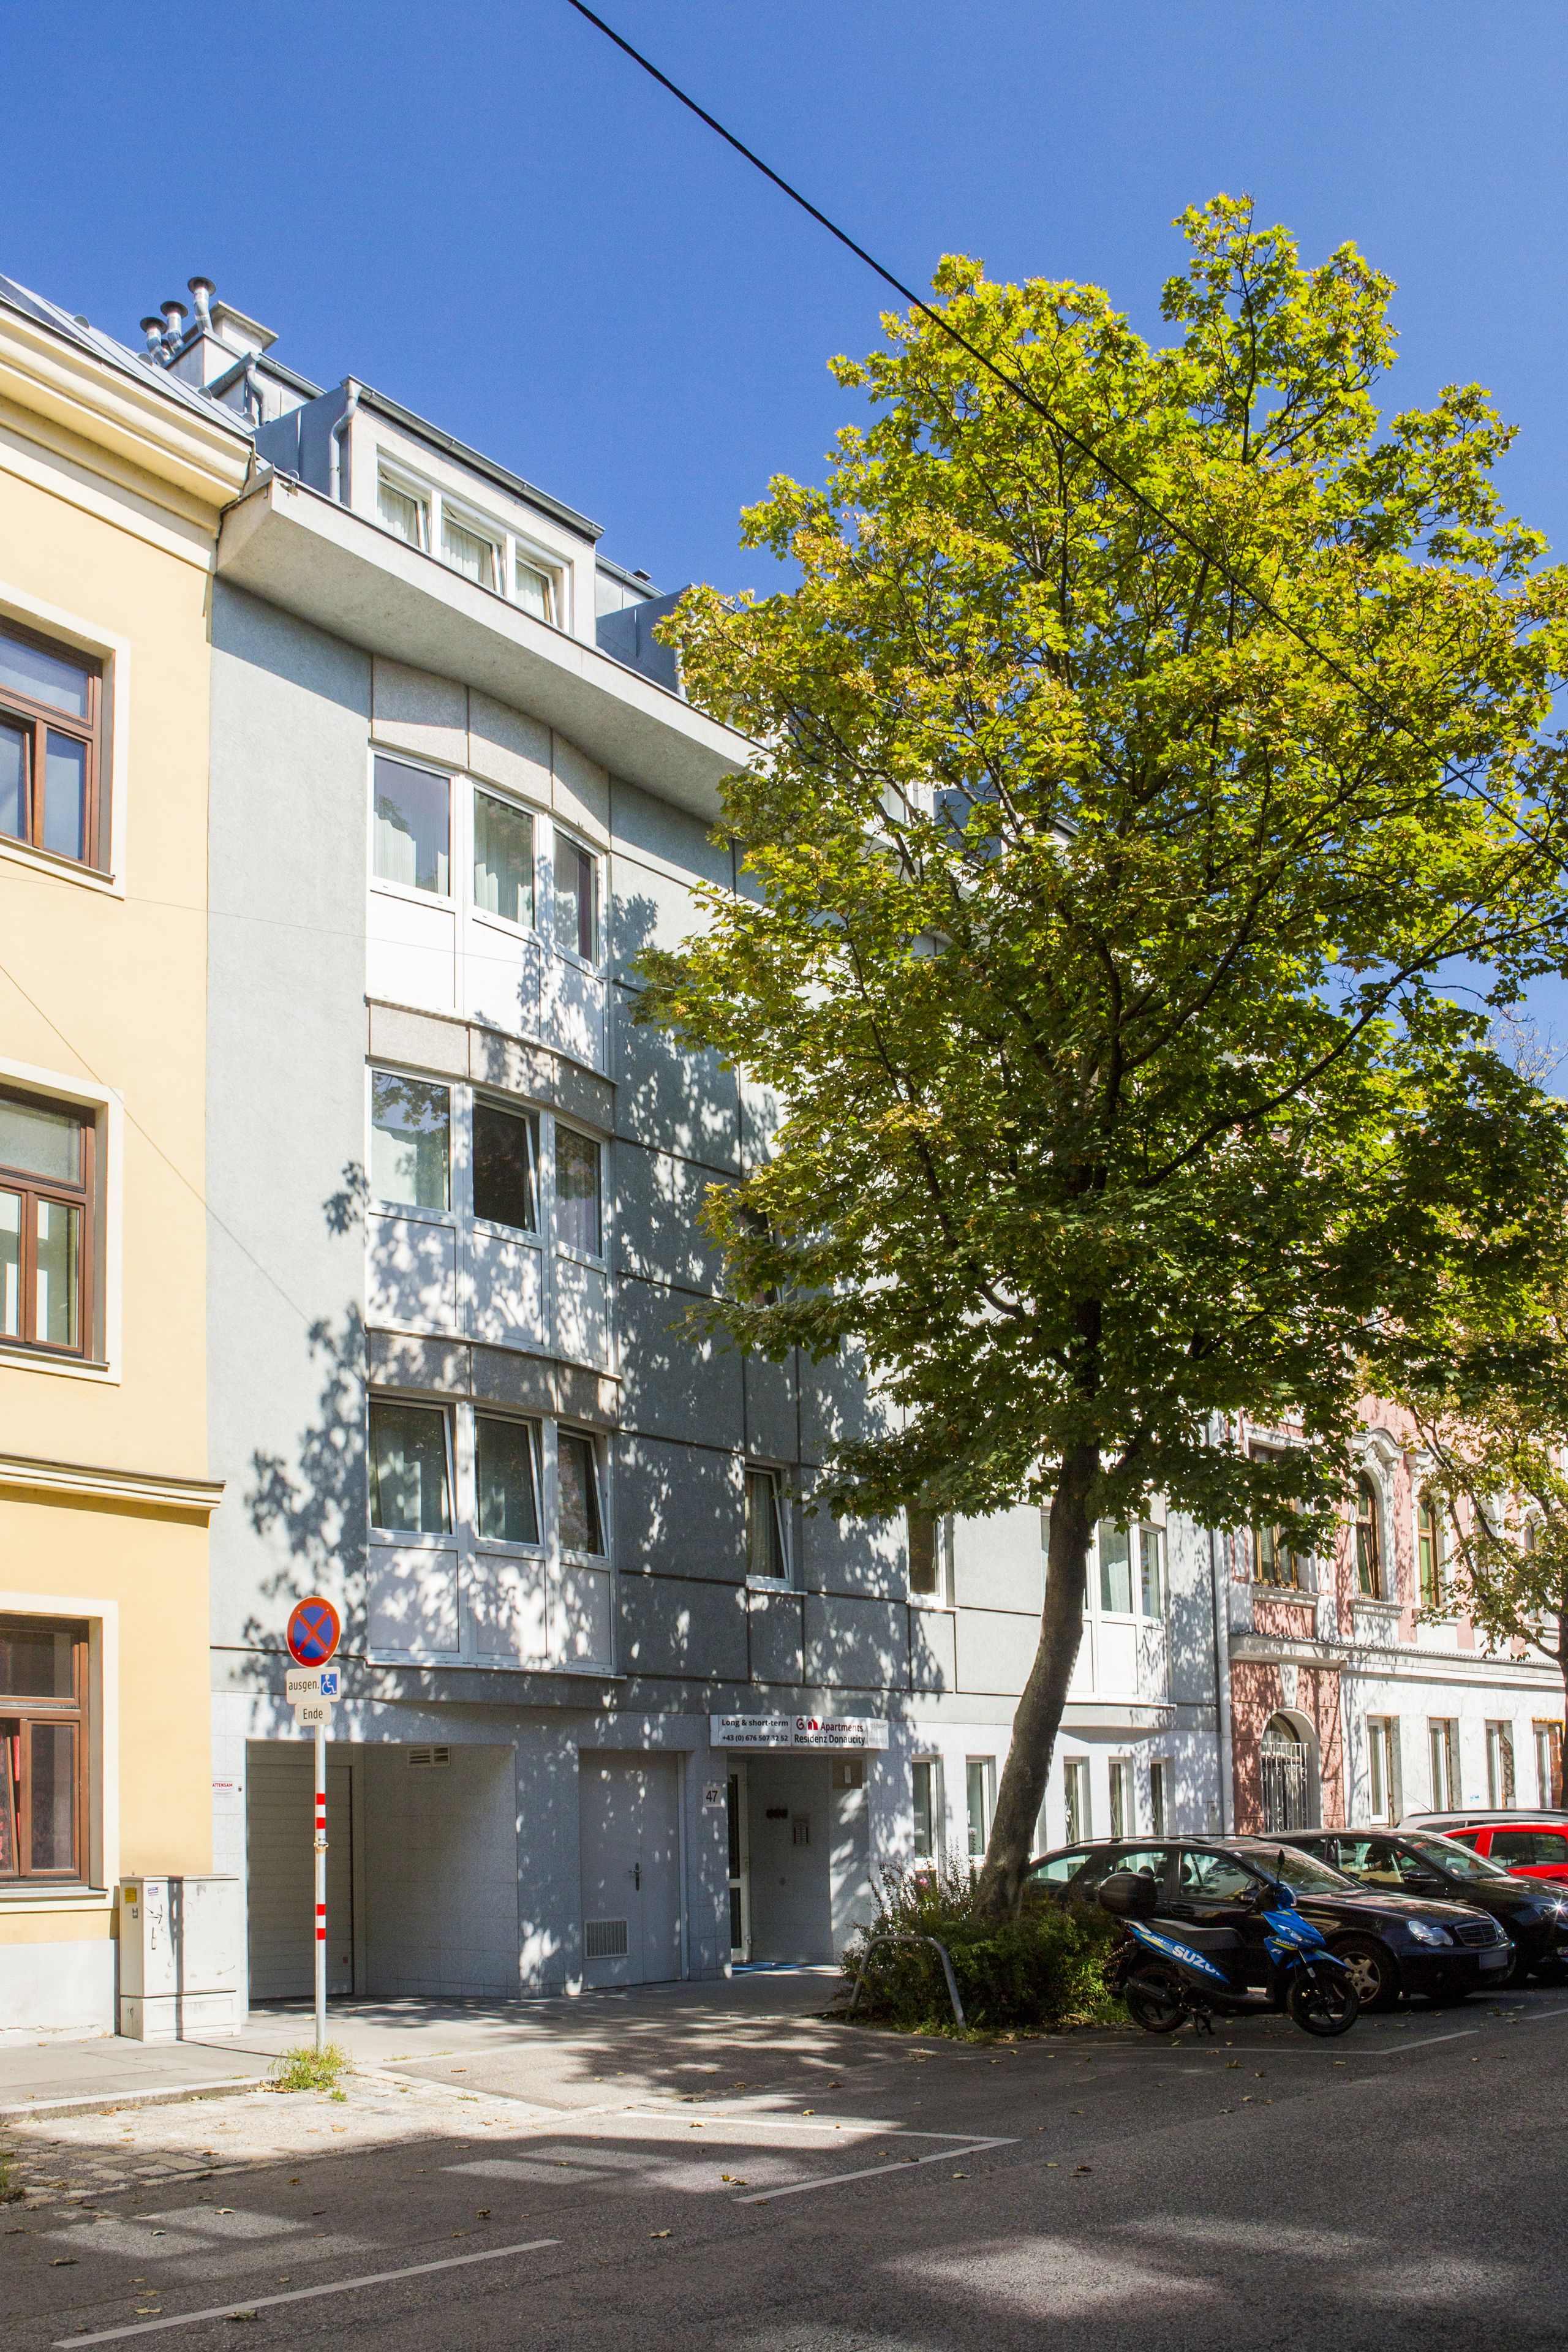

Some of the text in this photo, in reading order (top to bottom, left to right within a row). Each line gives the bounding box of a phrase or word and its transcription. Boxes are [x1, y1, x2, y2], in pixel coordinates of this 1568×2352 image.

[288, 1681, 320, 1692] ausgen.
[303, 1708, 323, 1719] Ende
[820, 1722, 864, 1733] Apartments
[794, 1734, 827, 1743] Residenz
[829, 1735, 865, 1746] Donaucity
[706, 1790, 718, 1803] 47
[1275, 1938, 1298, 1948] SUZUKI
